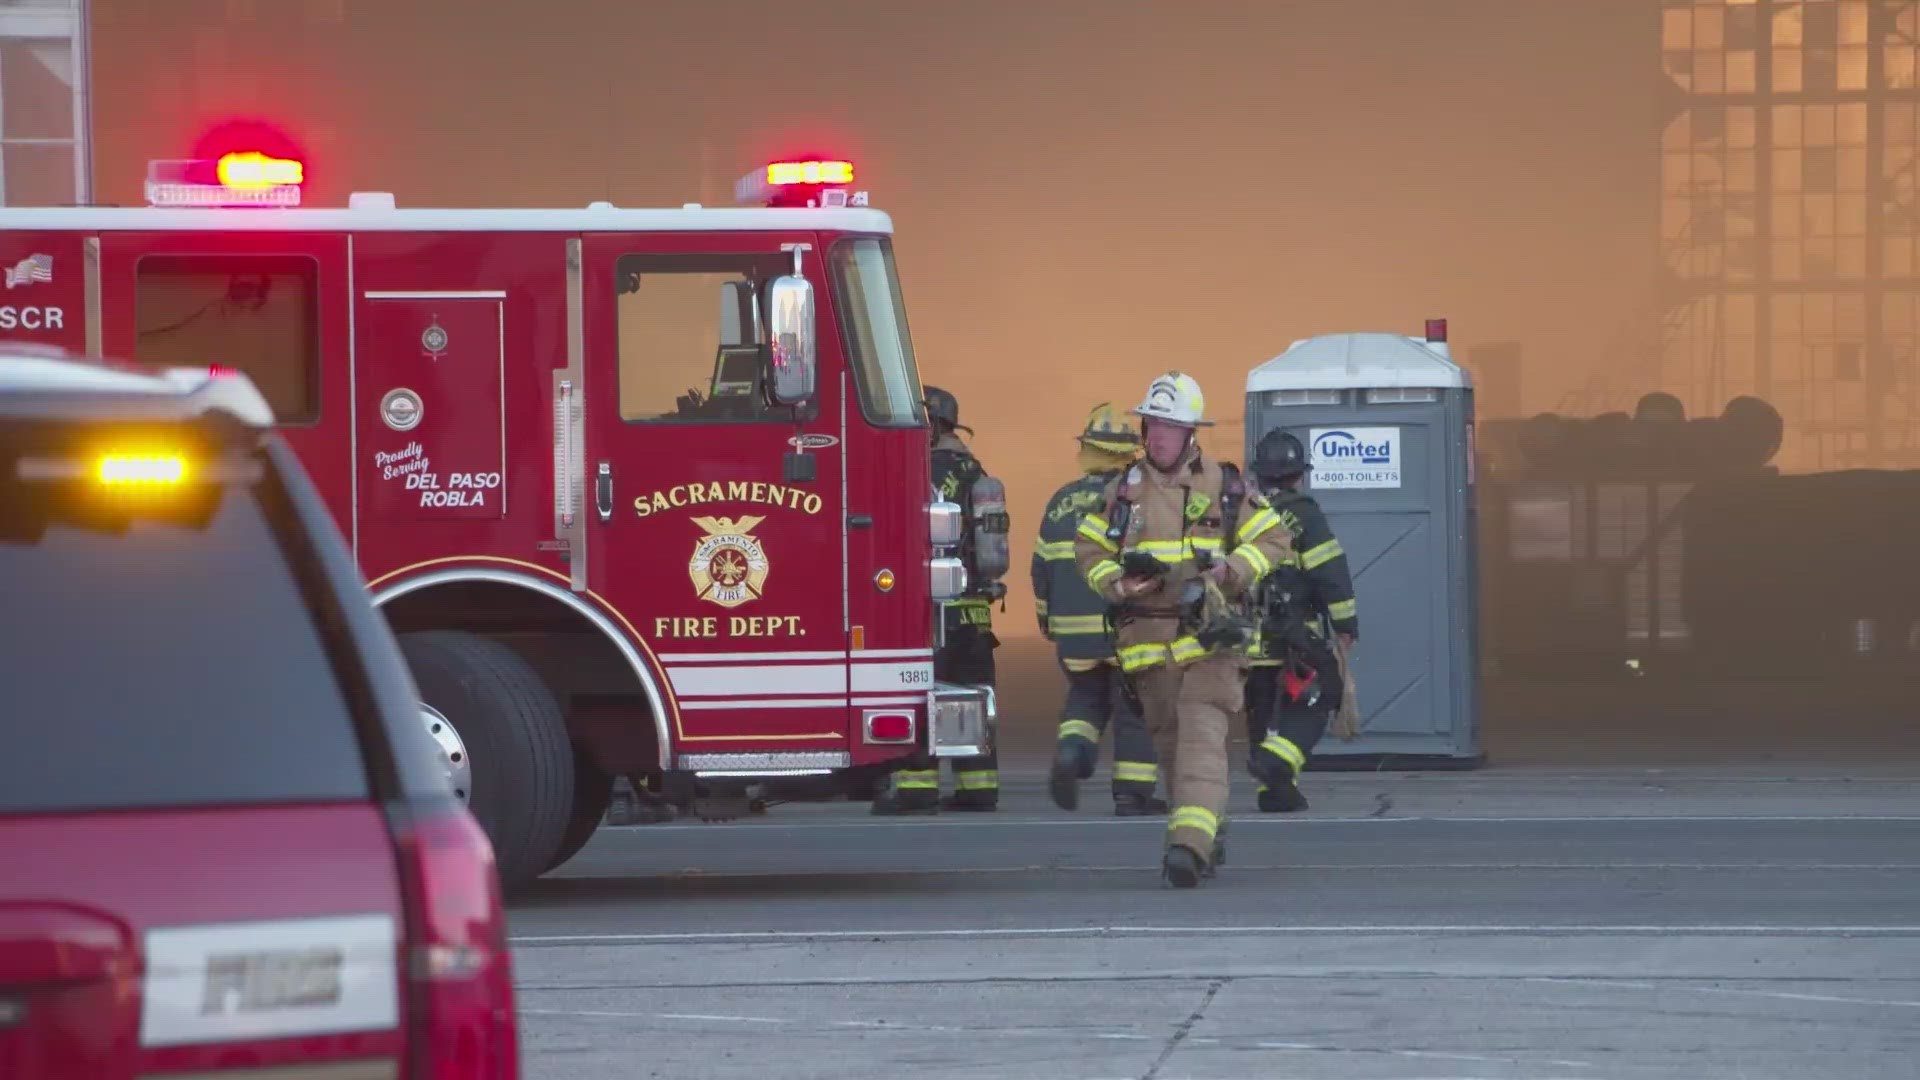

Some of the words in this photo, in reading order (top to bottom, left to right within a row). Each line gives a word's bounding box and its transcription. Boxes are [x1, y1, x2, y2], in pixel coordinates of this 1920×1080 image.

[375, 441, 423, 468] Proudly
[1322, 440, 1390, 457] United
[383, 457, 430, 481] Serving
[1314, 471, 1399, 482] 1-800-TOILETS
[405, 473, 440, 489] DEL
[449, 472, 501, 489] PASO
[420, 491, 485, 507] ROBLA
[634, 481, 822, 517] SACRAMENTO
[716, 588, 742, 600] FIRE
[655, 617, 718, 638] FIRE
[729, 615, 806, 637] DEPT.
[899, 669, 929, 684] 13813
